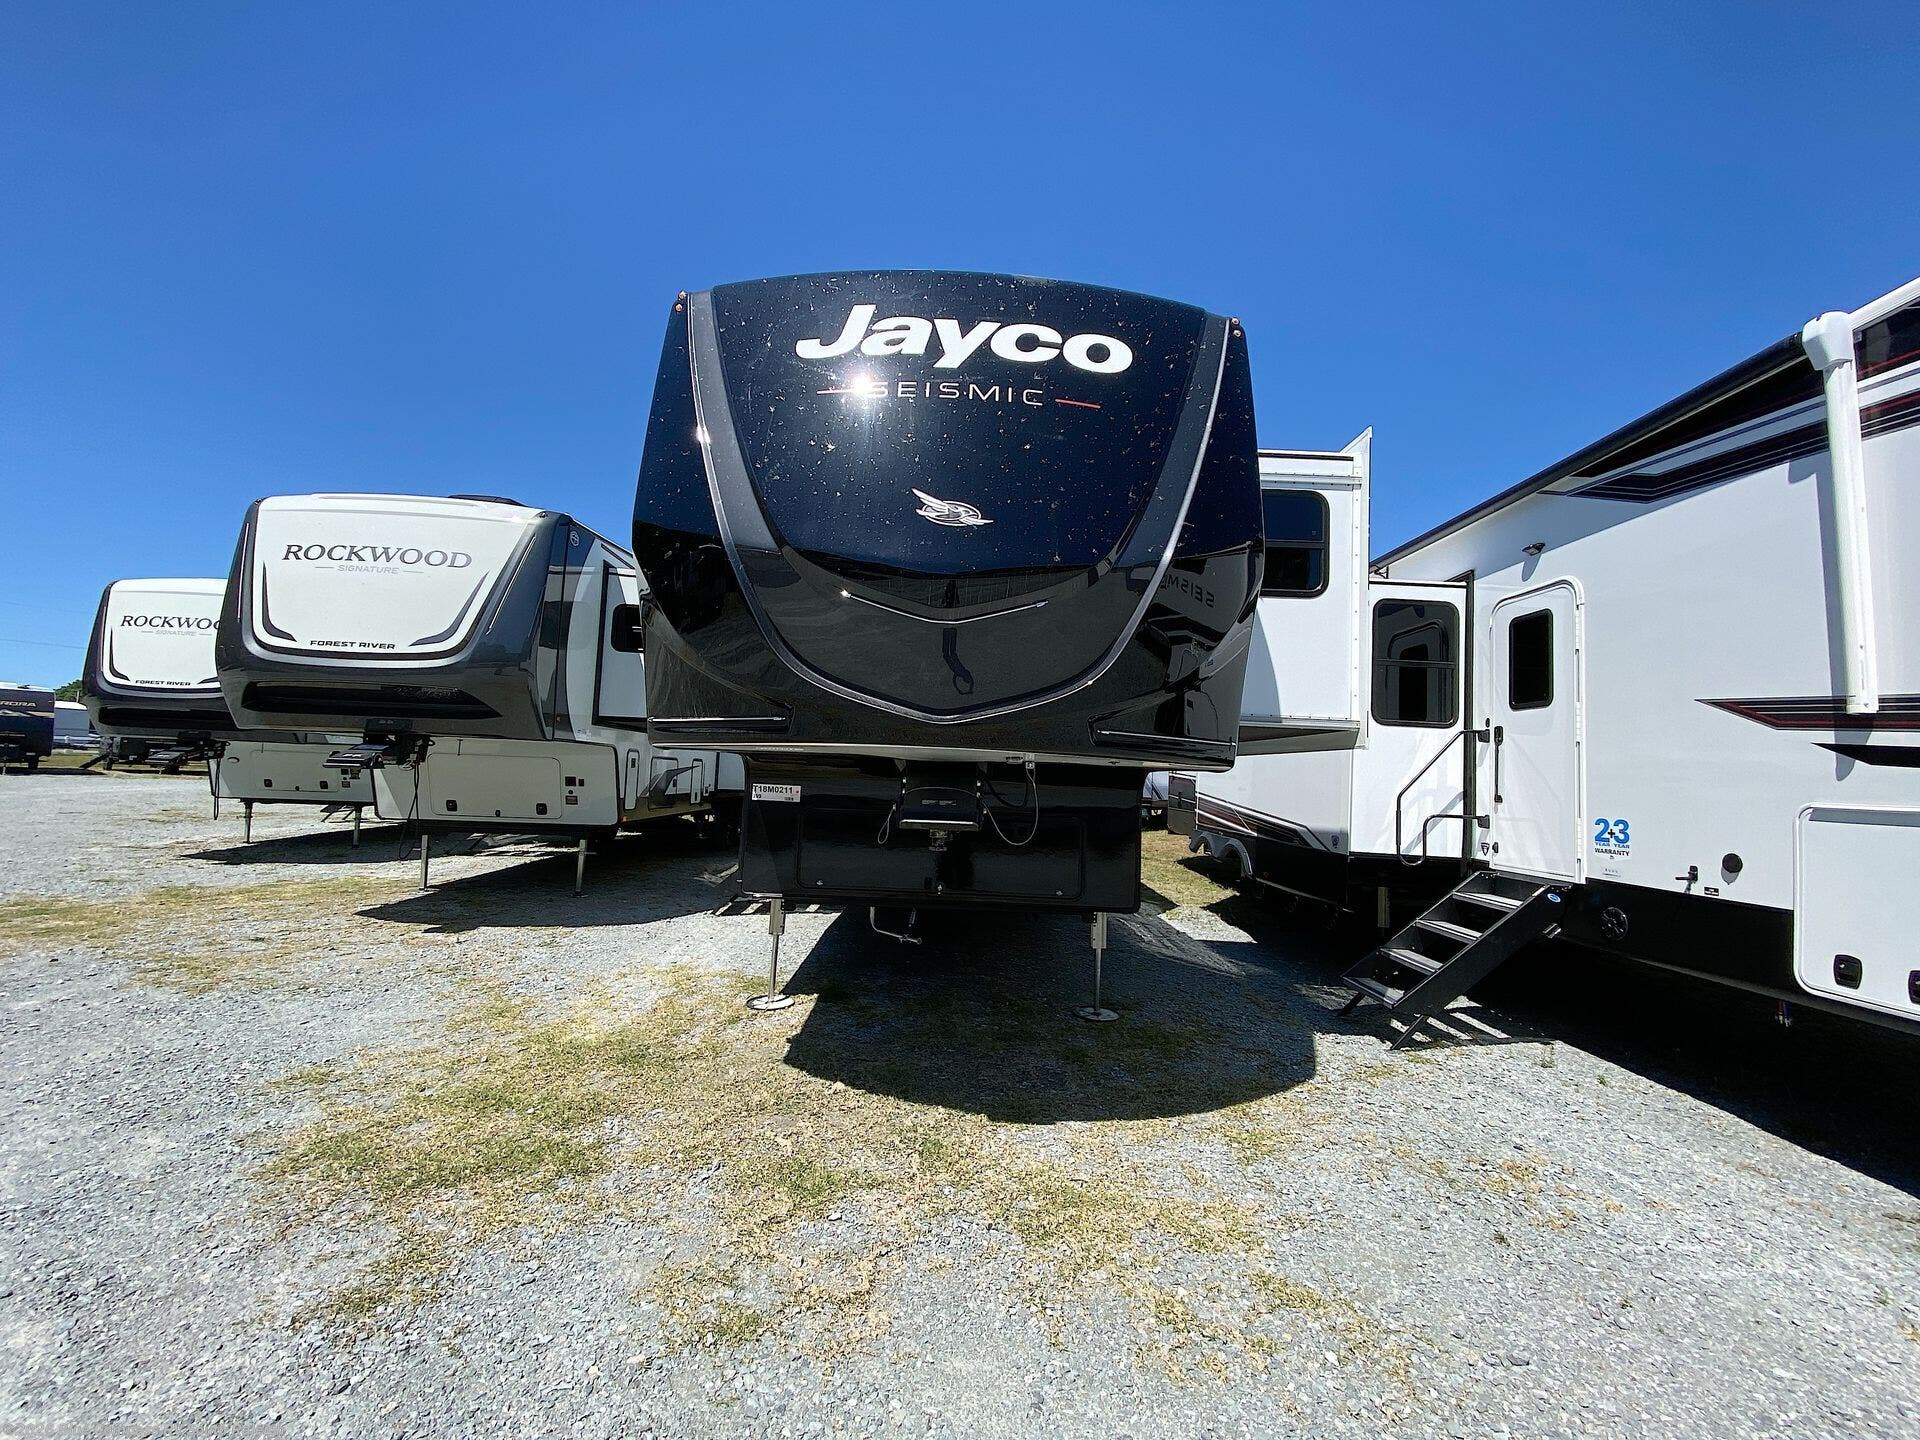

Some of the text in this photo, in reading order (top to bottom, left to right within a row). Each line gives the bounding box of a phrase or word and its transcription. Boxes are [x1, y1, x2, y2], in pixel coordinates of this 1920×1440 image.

[795, 304, 1134, 374] Jayco
[865, 381, 1043, 406] SEISMIC
[282, 544, 472, 568] ROCKWOOD
[337, 564, 400, 574] SIGNATURE
[310, 640, 356, 648] FOREST
[754, 785, 793, 794] T18M0211
[1594, 847, 1630, 856] WARRANTY
